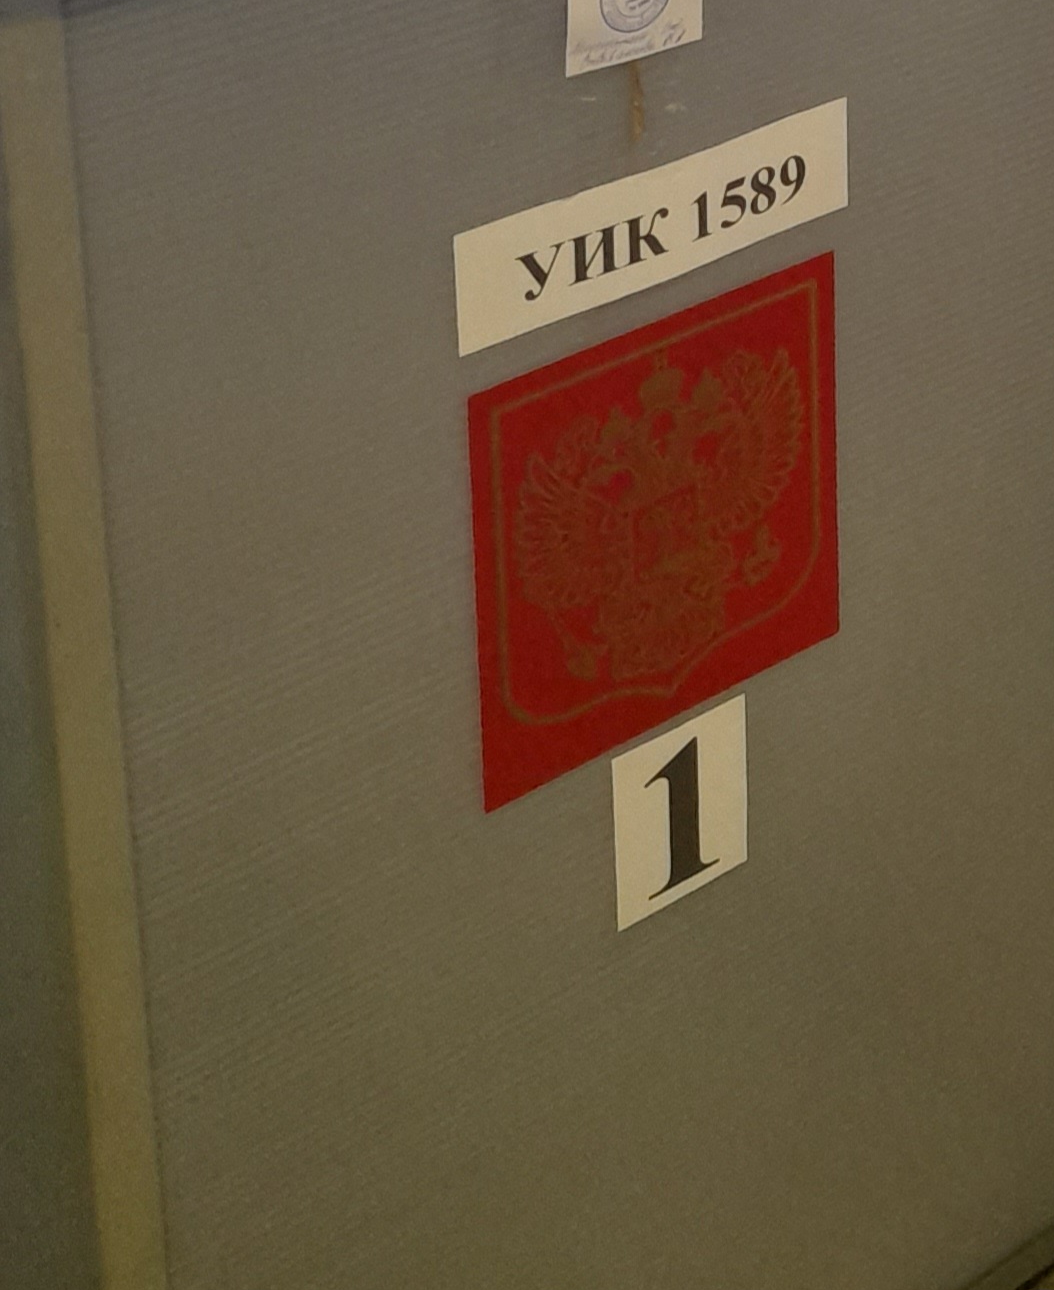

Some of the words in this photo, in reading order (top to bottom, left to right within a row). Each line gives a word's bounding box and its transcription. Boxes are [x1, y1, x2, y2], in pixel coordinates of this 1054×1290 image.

[515, 207, 669, 301] УИК
[691, 155, 807, 243] 1589
[644, 735, 720, 901] 1
